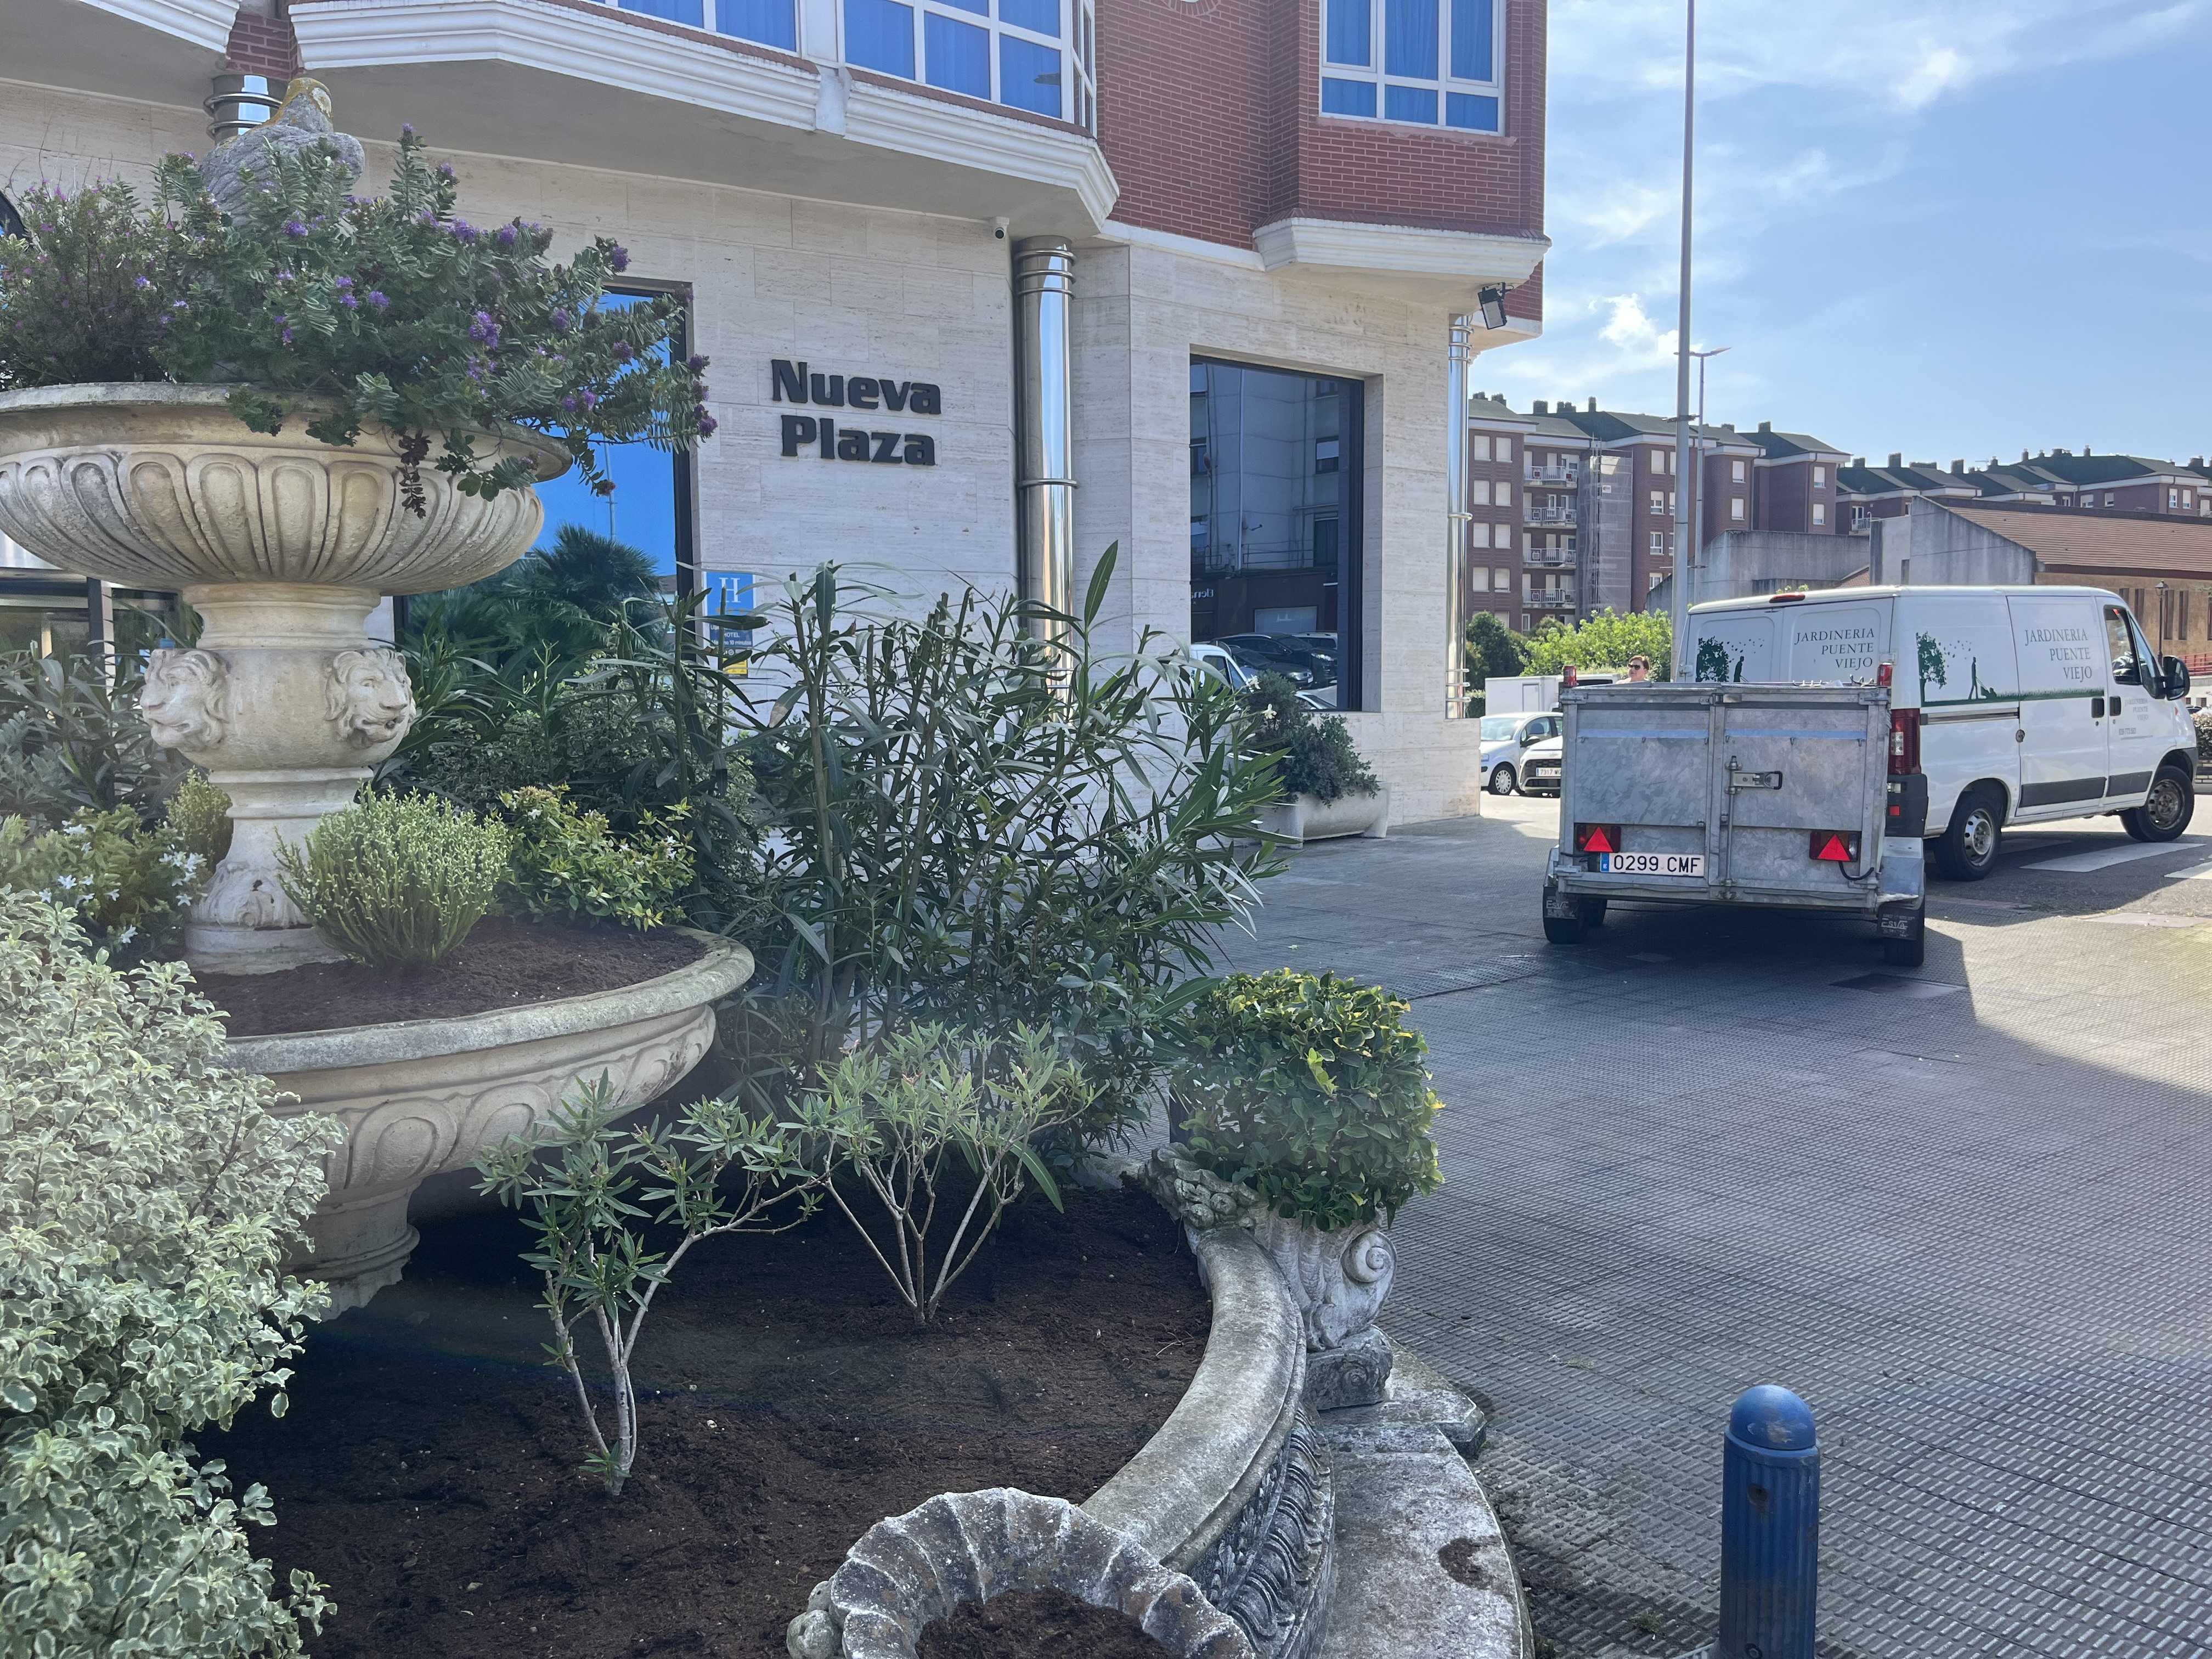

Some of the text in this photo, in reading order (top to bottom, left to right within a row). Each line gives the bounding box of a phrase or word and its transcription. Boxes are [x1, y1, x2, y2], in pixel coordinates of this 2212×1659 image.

[771, 359, 941, 415] Nueva
[781, 415, 936, 466] Plaza
[719, 577, 741, 602] H
[1794, 628, 1875, 645] JARDINERIA
[2024, 628, 2089, 646] JARDINERIA
[1821, 642, 1874, 655] PUENTE
[2049, 647, 2091, 661] PUENTE
[1835, 657, 1873, 671] VIEJO
[2063, 666, 2092, 683] VIEJO
[1613, 855, 1701, 873] 0299 CMF
